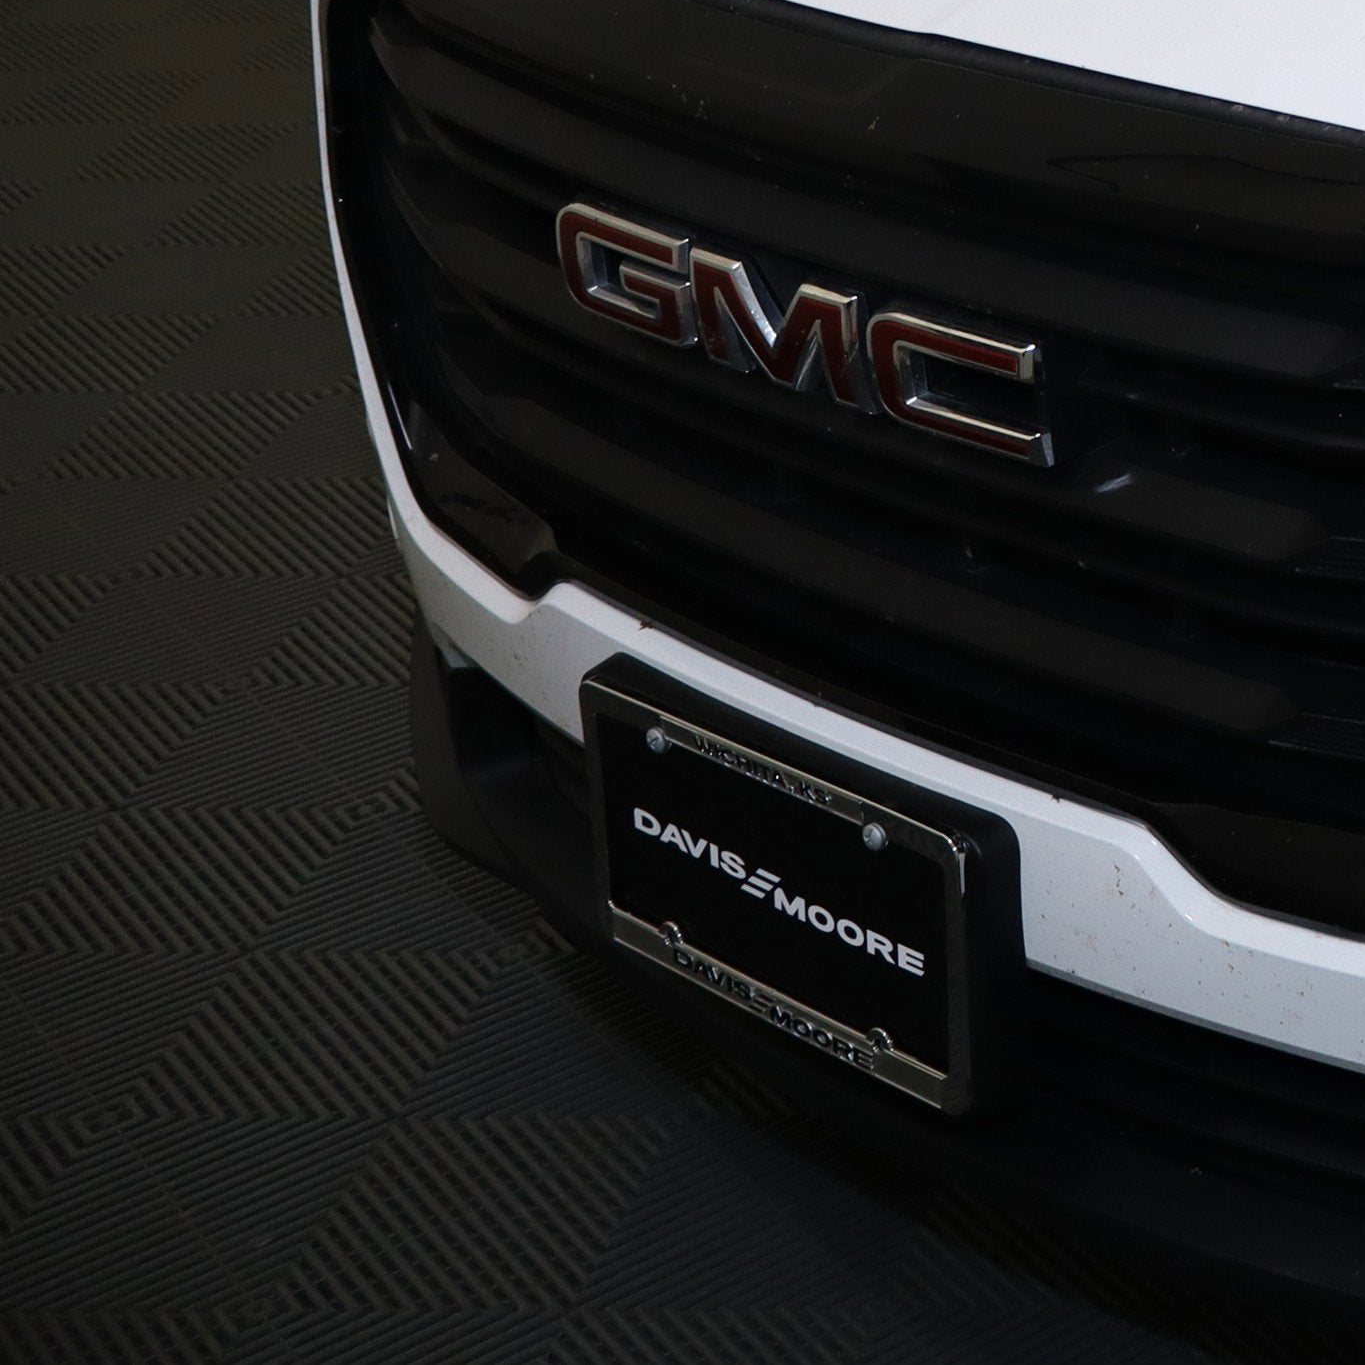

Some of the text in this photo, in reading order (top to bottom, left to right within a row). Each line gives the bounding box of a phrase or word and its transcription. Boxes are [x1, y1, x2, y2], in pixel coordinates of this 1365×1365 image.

[555, 202, 1056, 468] GMC
[633, 807, 926, 977] DAVIS MOORE
[674, 947, 875, 1071] DAVIS MOORE
